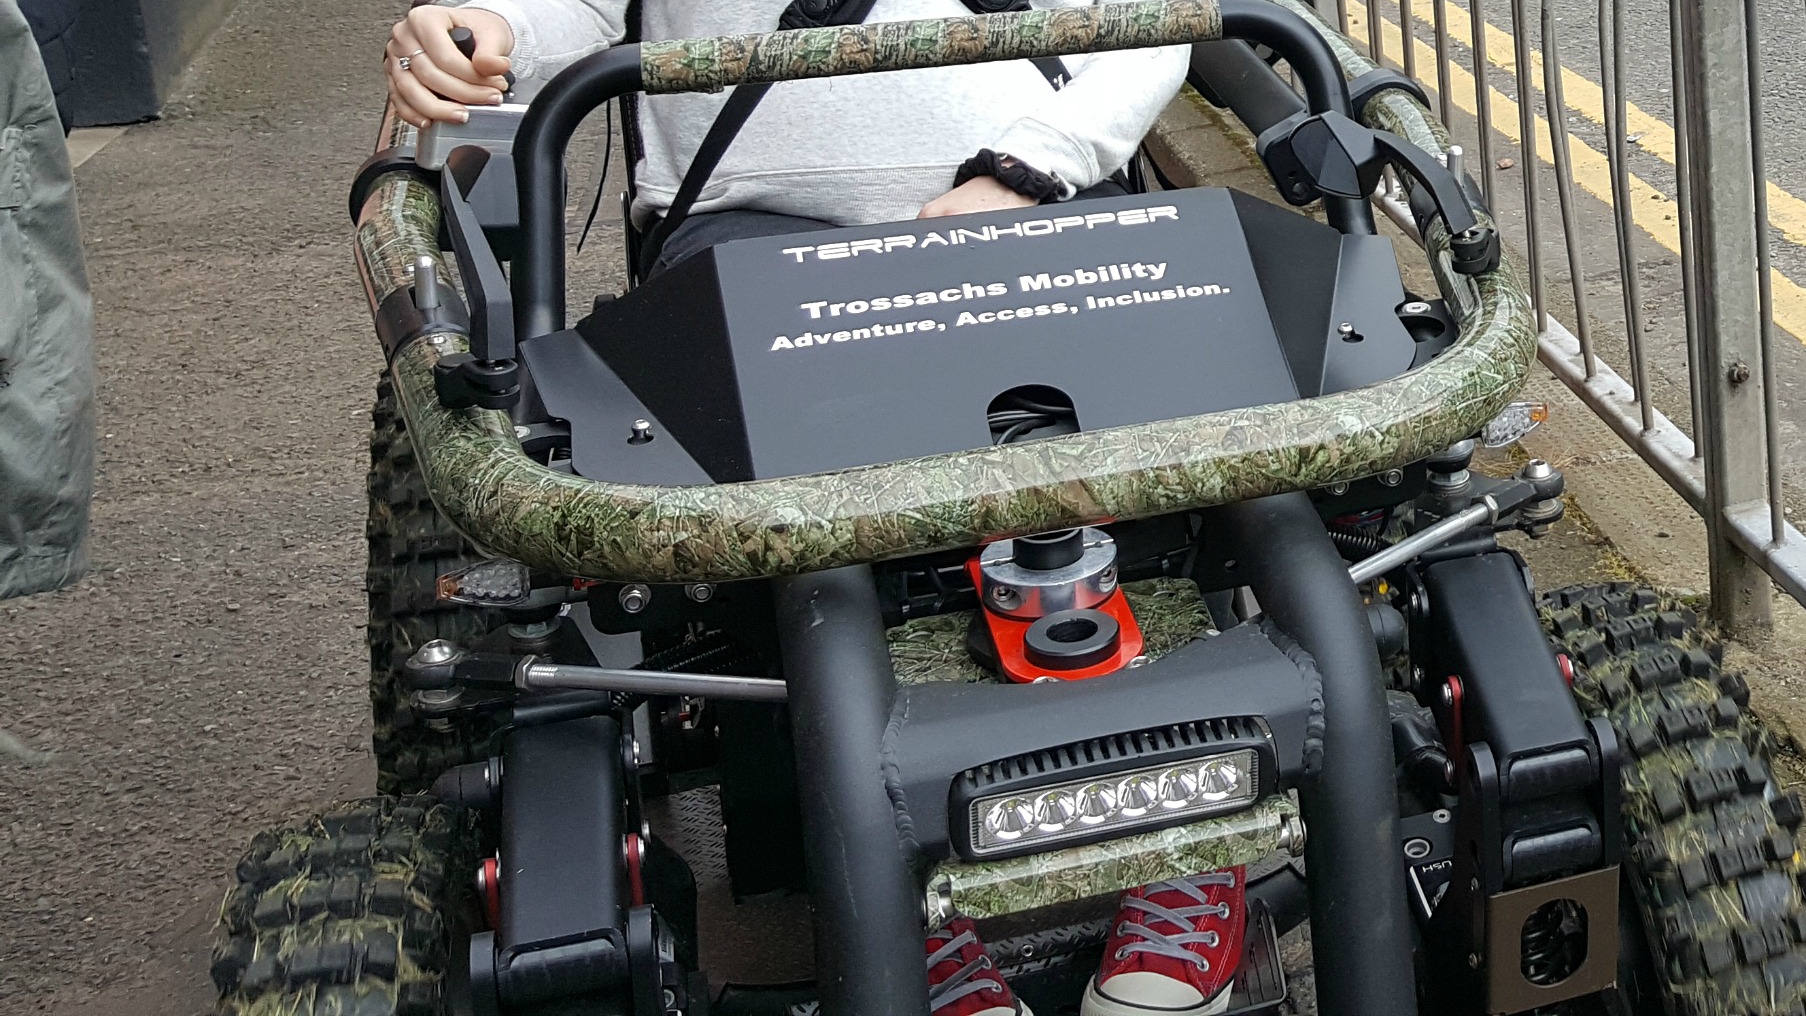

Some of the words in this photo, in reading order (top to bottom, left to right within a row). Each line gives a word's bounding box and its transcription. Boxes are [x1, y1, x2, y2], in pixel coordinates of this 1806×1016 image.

[782, 205, 1180, 263] TERRAINHOPPER
[769, 318, 947, 351] Adventure,
[955, 301, 1079, 327] Access,
[1085, 283, 1231, 310] Inclusion.
[800, 281, 1009, 319] Trossachs
[1018, 262, 1167, 292] Mobility
